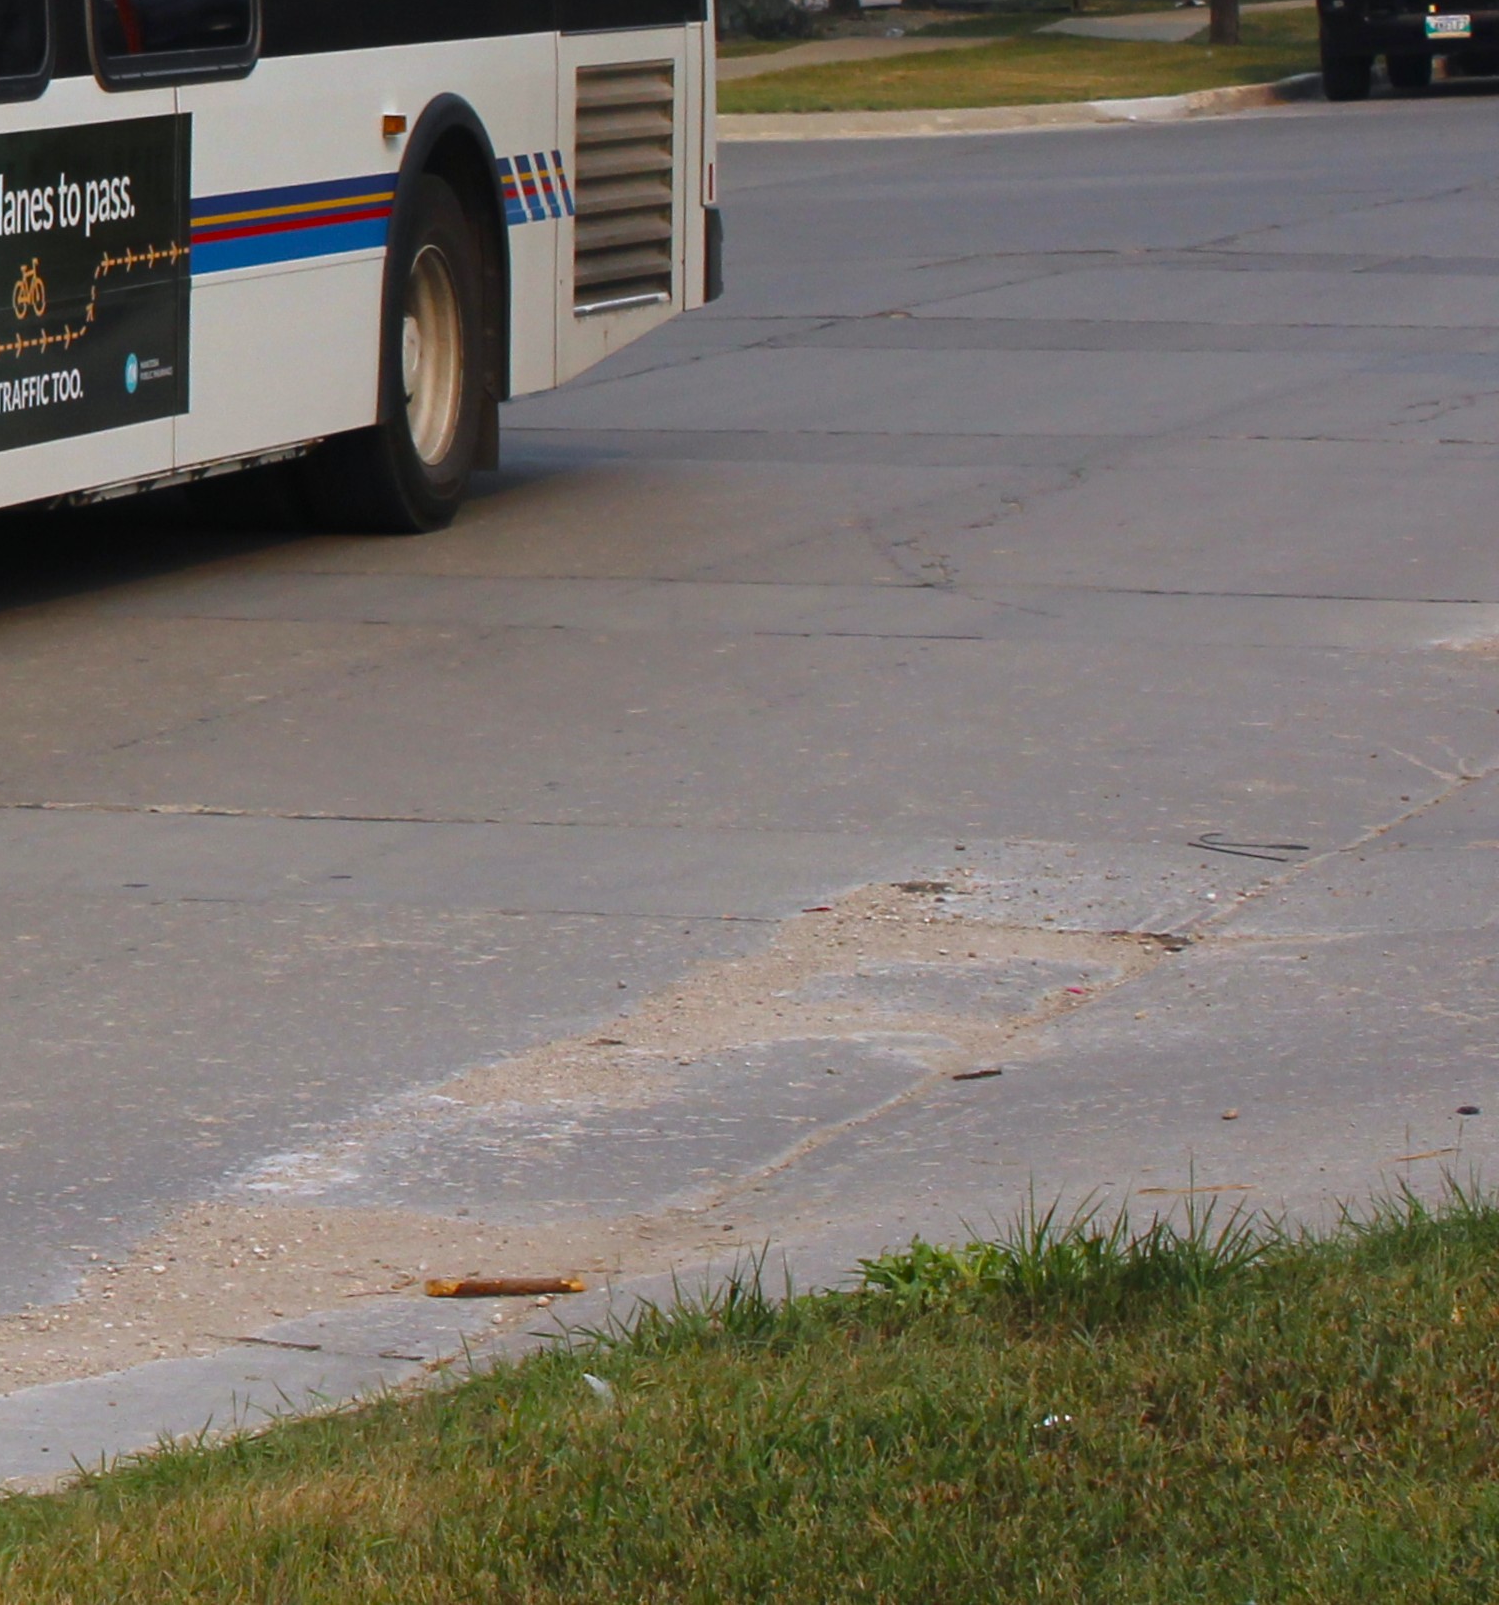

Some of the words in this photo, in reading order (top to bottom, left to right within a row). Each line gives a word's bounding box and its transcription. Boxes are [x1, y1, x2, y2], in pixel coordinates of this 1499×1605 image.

[57, 172, 82, 228] to
[85, 175, 136, 237] pass.
[51, 367, 84, 403] TOO.
